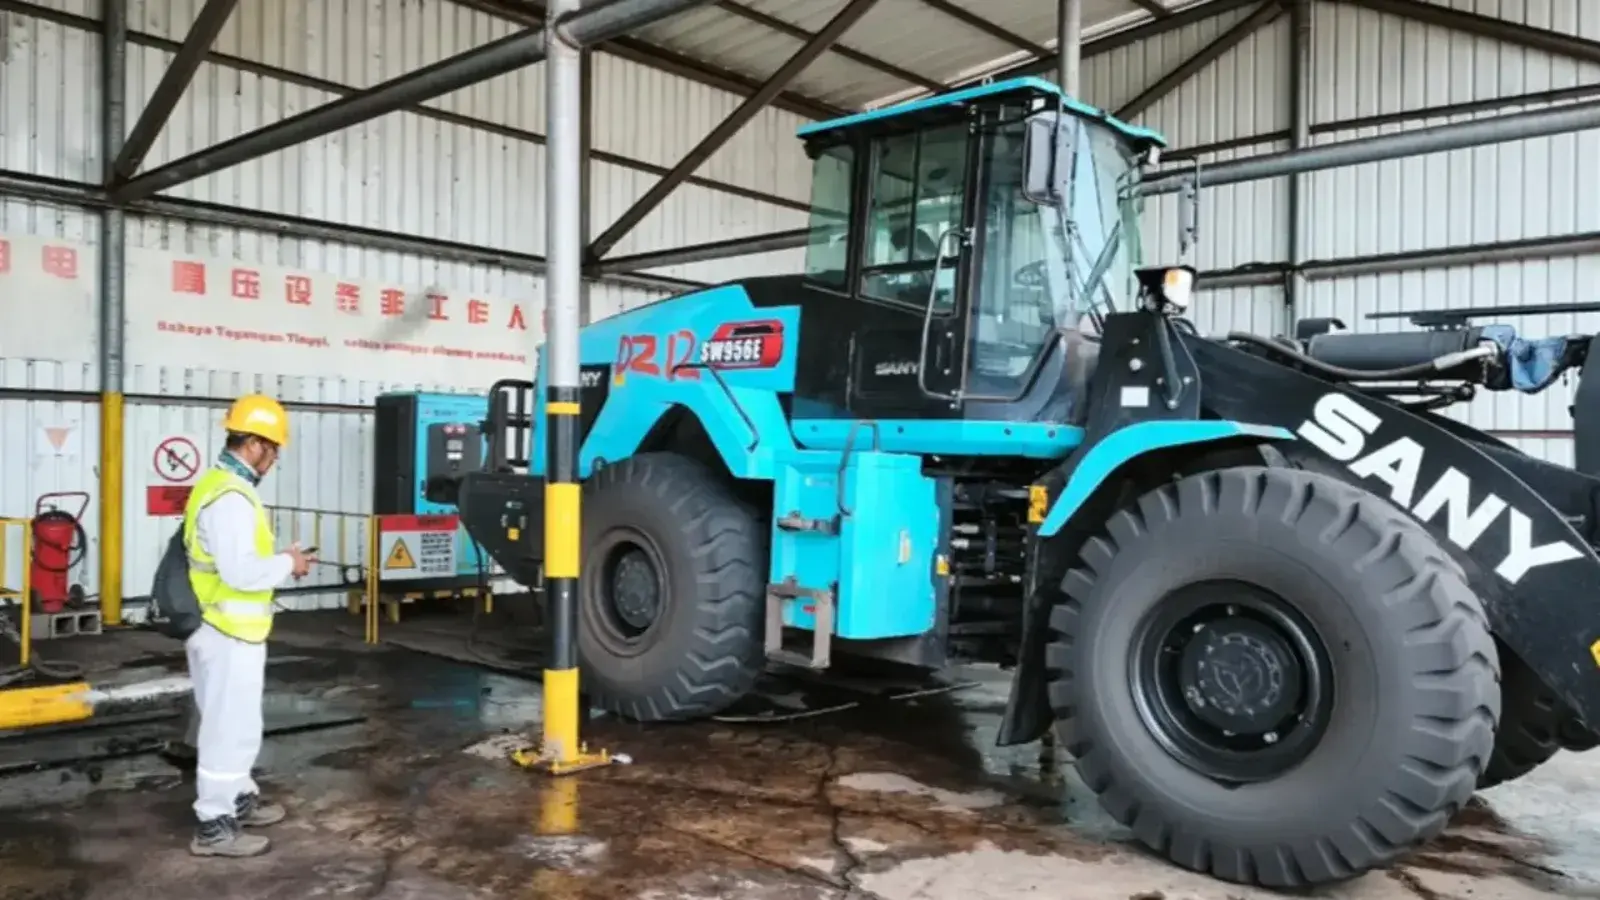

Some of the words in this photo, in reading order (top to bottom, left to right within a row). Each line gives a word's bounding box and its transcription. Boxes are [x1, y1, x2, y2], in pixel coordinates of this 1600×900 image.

[700, 338, 762, 362] SW956E
[580, 370, 602, 387] NY
[875, 361, 921, 376] SANY
[1296, 392, 1585, 585] SANY
